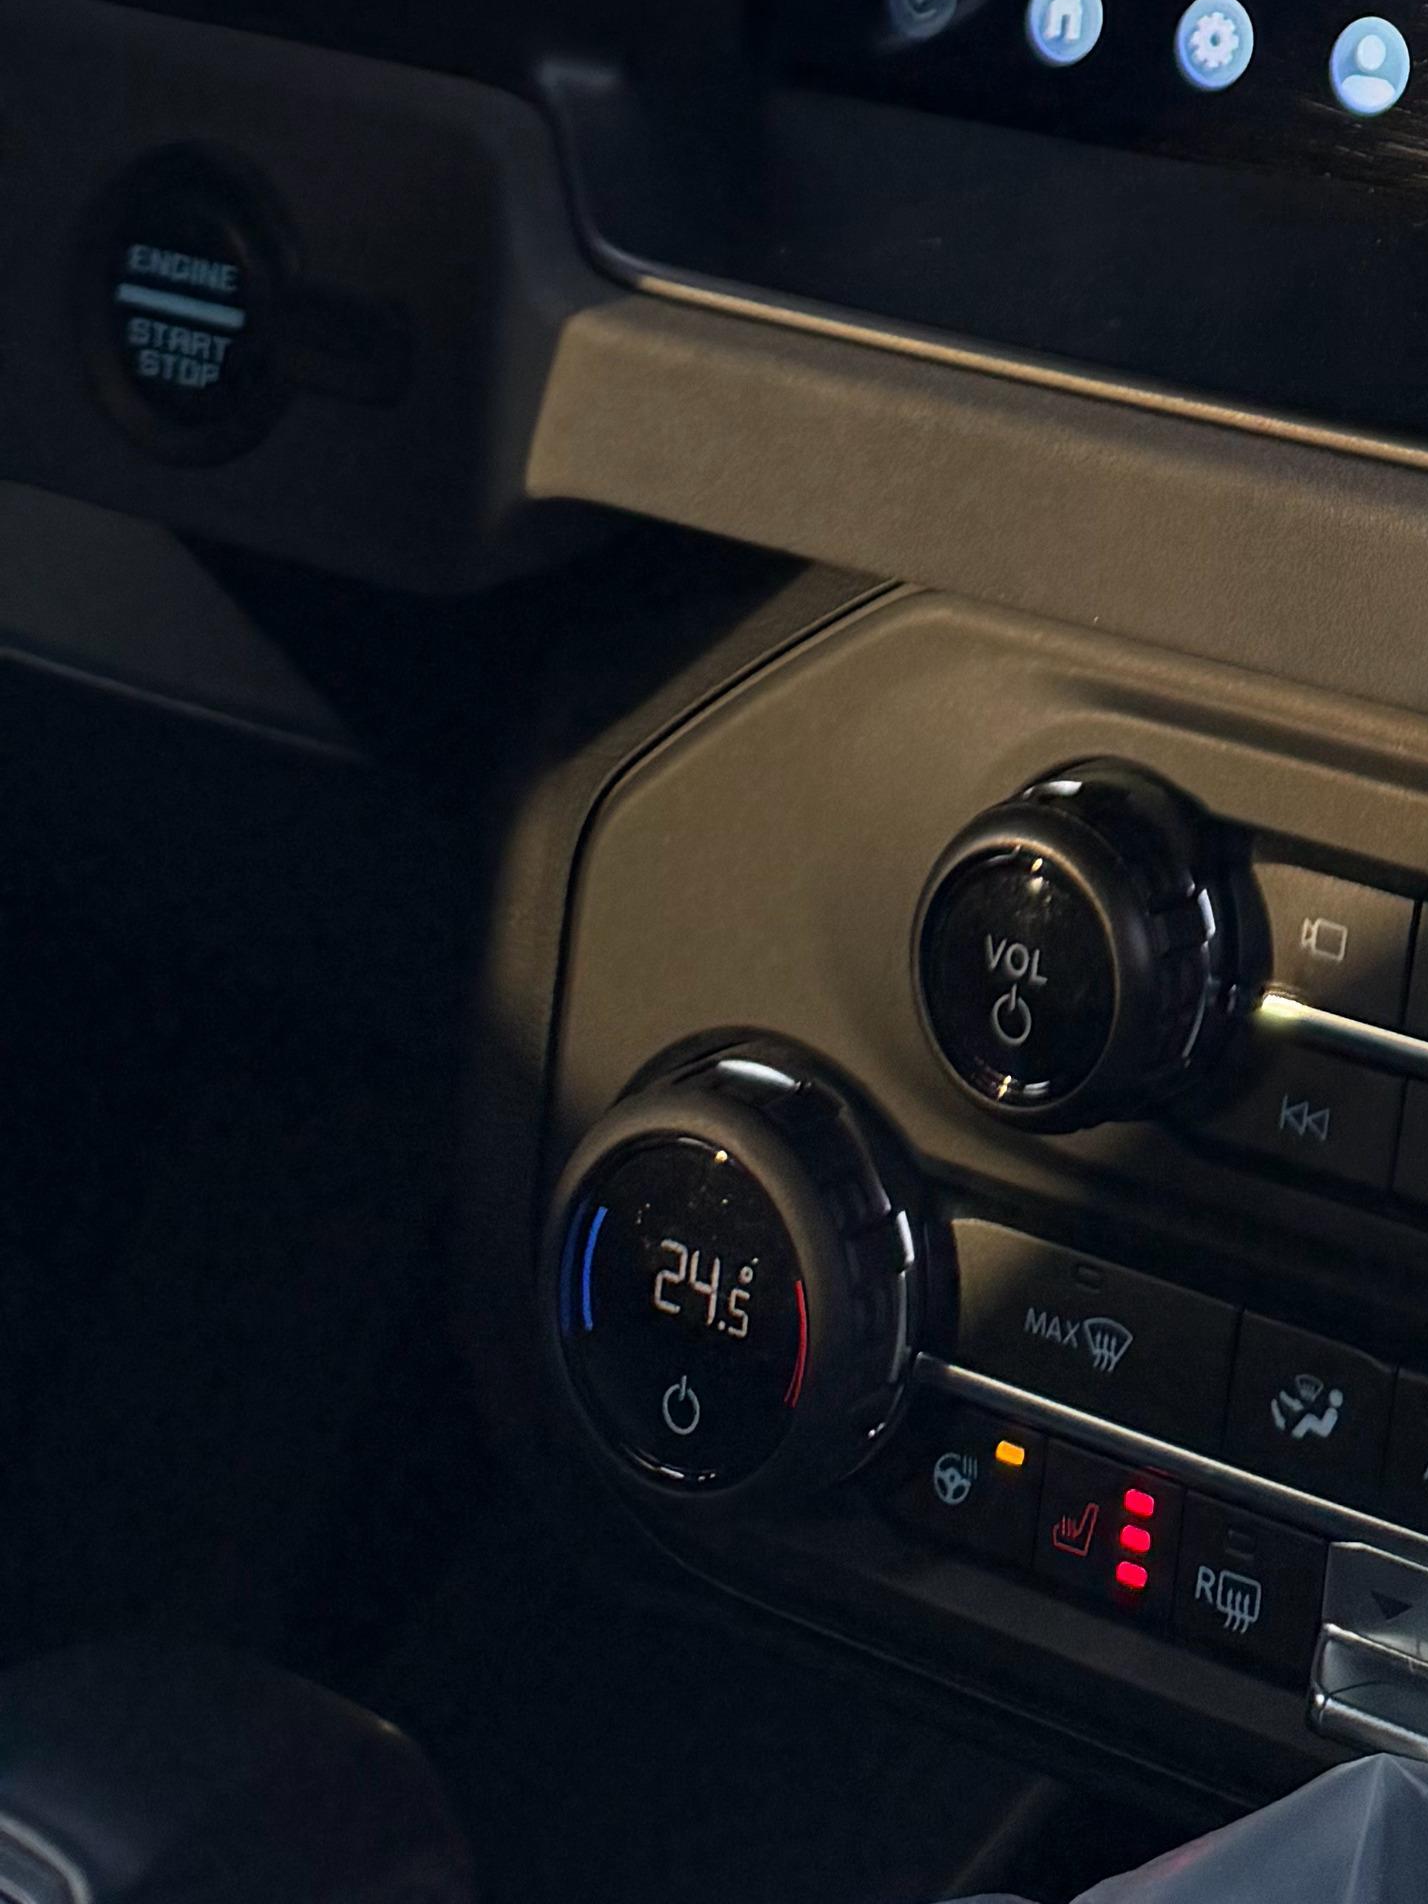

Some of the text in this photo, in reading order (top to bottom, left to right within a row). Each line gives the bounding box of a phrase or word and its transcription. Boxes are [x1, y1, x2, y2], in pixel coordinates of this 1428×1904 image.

[127, 243, 238, 292] ENGINE
[127, 316, 233, 363] START
[137, 348, 221, 389] STOP
[984, 934, 1049, 988] VOL
[1024, 1306, 1081, 1348] MAX
